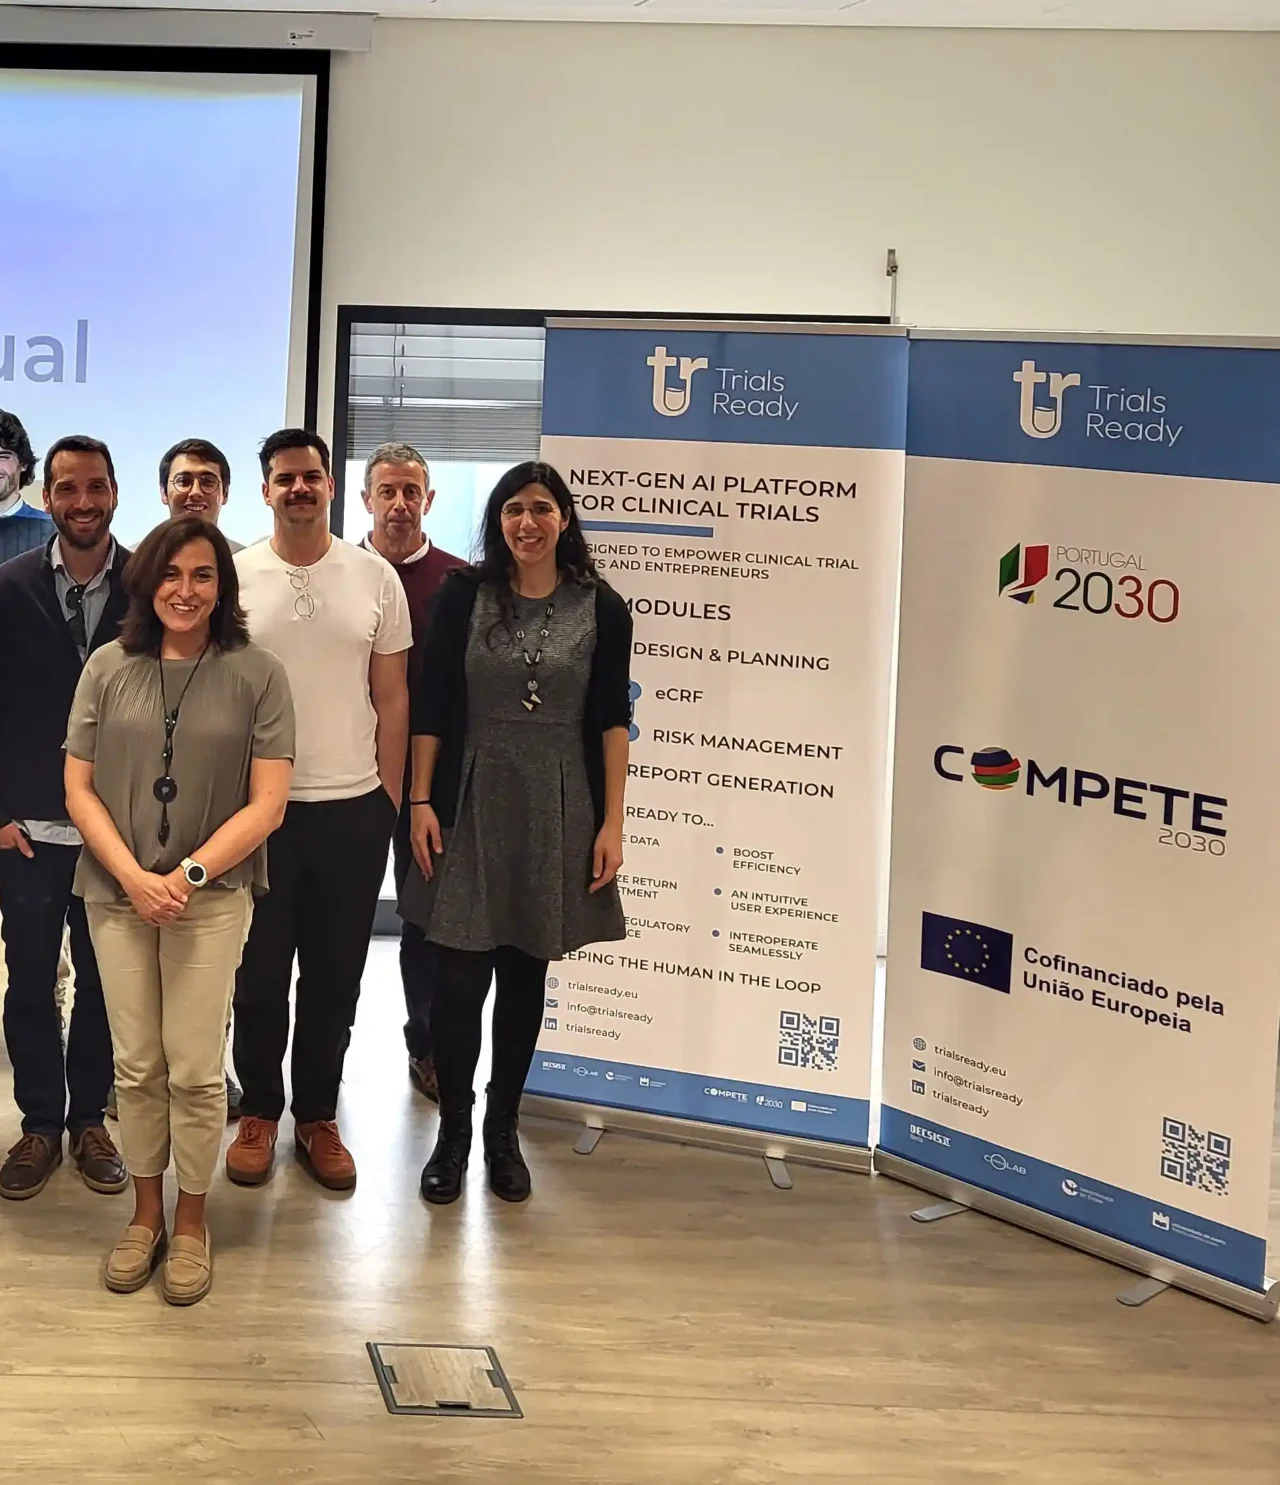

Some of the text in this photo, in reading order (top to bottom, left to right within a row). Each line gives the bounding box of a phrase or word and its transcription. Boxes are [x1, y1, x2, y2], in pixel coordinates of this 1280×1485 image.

[715, 368, 785, 392] Trials
[713, 393, 799, 421] Ready
[1088, 385, 1167, 414] Trials
[1085, 413, 1183, 447] Ready
[570, 469, 857, 499] NEXT-GEN AI PLATFORM
[622, 496, 729, 518] CLINICAL
[736, 502, 820, 523] TRIALS
[586, 543, 859, 570] SIGNED TO EMPOWER CLINICAL TRIAL
[609, 559, 641, 571] AND
[645, 562, 770, 580] ENTREPRENEURS
[1056, 545, 1147, 571] PORTUGAL
[1052, 567, 1180, 623] 2030
[634, 642, 830, 671] DESIGN & PLANNING
[655, 688, 704, 703] eCRF
[653, 729, 843, 760] RISK MANAGEMENT
[627, 763, 834, 798] REPORT GENERATION
[933, 744, 1228, 837] COMPETE
[626, 806, 714, 827] READY TO...
[630, 835, 660, 847] DATA
[1158, 827, 1226, 857] 2030
[733, 848, 774, 861] BOOST
[733, 860, 801, 876] EFFICIENCY
[632, 876, 678, 890] RETURN
[731, 889, 809, 907] AN INTUITIVE
[624, 916, 691, 933] EGULATORY
[730, 902, 839, 923] USER EXPERIENCE
[728, 943, 804, 961] SEAMLESSLY
[729, 931, 819, 951] INTEROPERATE
[618, 956, 649, 970] THE
[653, 961, 713, 980] HUMAN
[718, 970, 735, 984] IN
[739, 973, 771, 988] THE
[775, 977, 822, 994] LOOP
[1023, 946, 1225, 1016] Cofinanciado pela
[567, 981, 638, 999] trialsready.eu
[1022, 970, 1192, 1033] União Europeia
[566, 1002, 654, 1025] info@trialsready
[566, 1022, 622, 1041] trialsready
[934, 1045, 1007, 1077] trialsready.eu
[703, 1087, 748, 1101] COMPETE
[933, 1066, 1024, 1106] info@trialsready
[764, 1099, 783, 1109] 2030
[932, 1088, 990, 1117] trialsready
